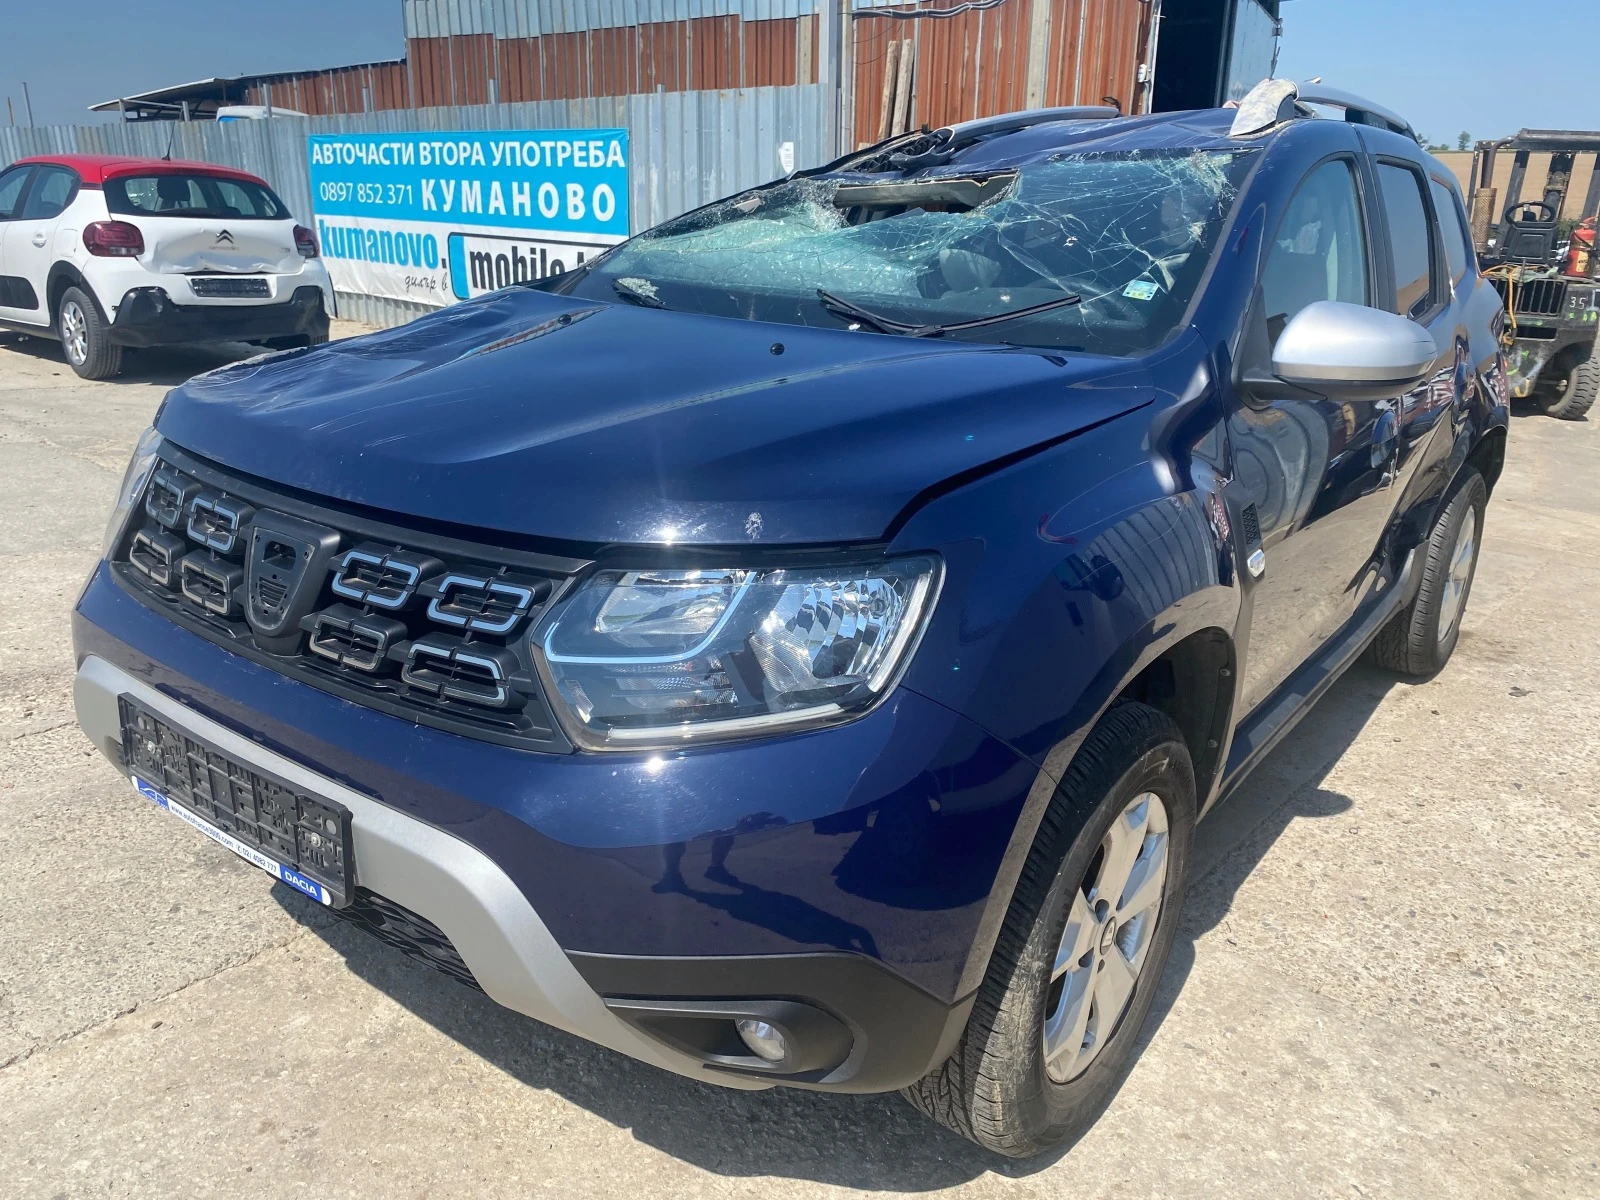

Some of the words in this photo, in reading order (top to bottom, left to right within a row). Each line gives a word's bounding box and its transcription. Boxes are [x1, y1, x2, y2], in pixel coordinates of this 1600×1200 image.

[312, 142, 415, 166] АВТОЧАСТИ
[419, 141, 486, 166] ВТОРА
[489, 140, 626, 168] УПОТРЕБА
[319, 181, 354, 202] 0897
[357, 182, 384, 204] 852
[387, 184, 413, 205] 371
[421, 178, 616, 222] КУМАНОВО
[284, 870, 318, 897] DACIA
